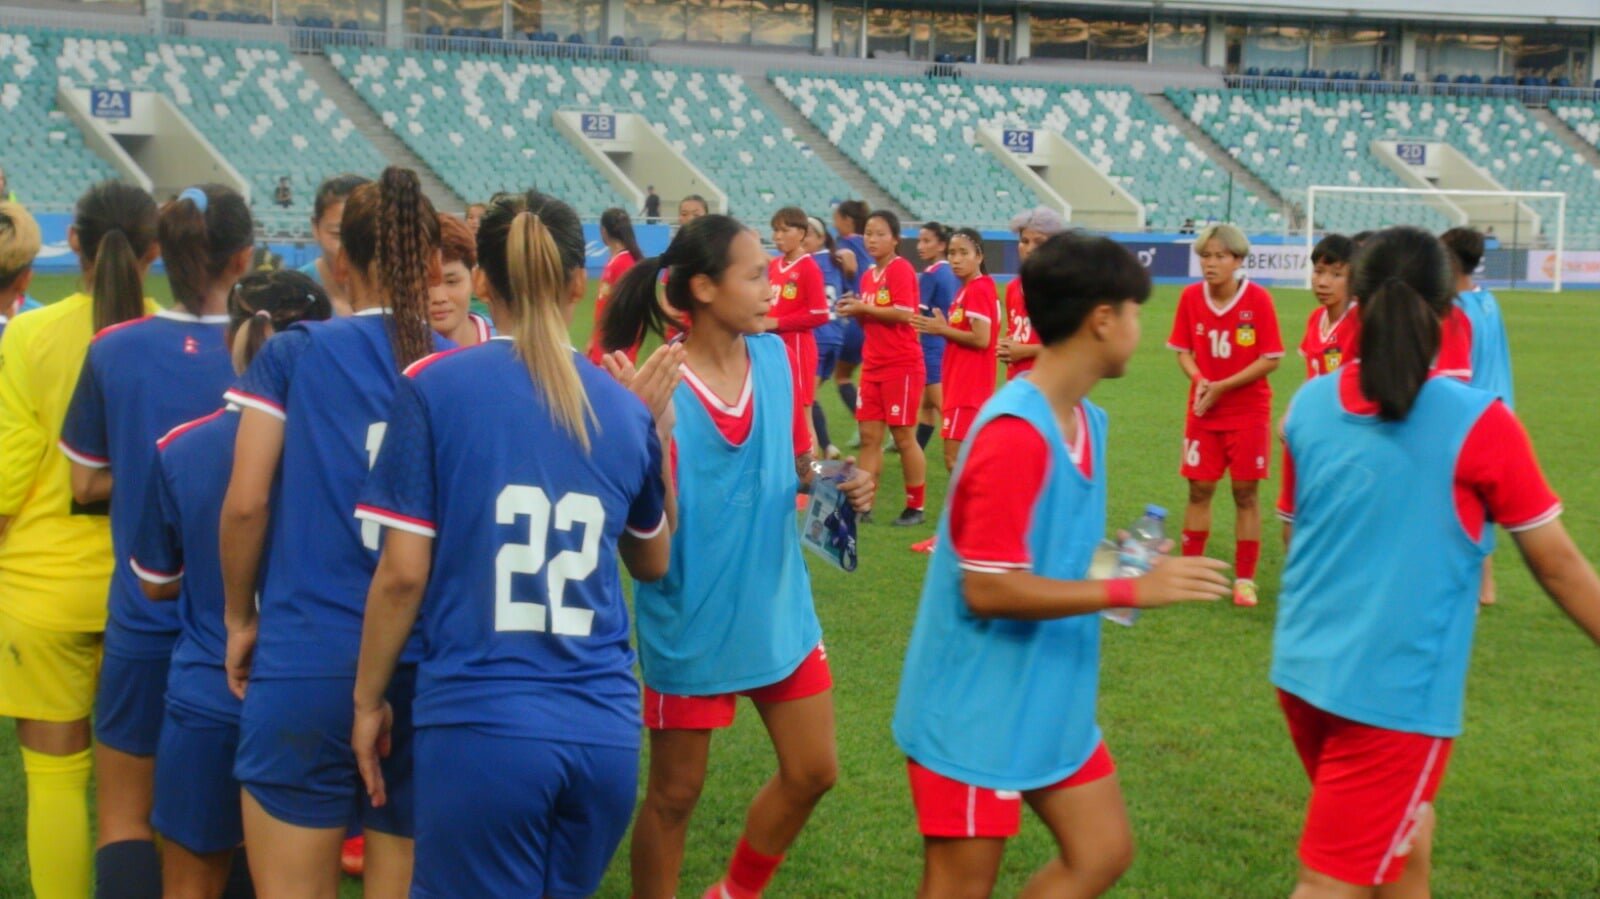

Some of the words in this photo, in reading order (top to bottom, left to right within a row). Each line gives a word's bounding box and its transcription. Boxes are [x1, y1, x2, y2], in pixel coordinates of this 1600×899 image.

[97, 91, 125, 108] 2A
[588, 116, 610, 130] 2B
[1008, 132, 1029, 145] 2C
[1401, 145, 1421, 158] 2D
[1014, 315, 1031, 343] 23
[1208, 330, 1231, 359] 16
[495, 484, 605, 636] 22
